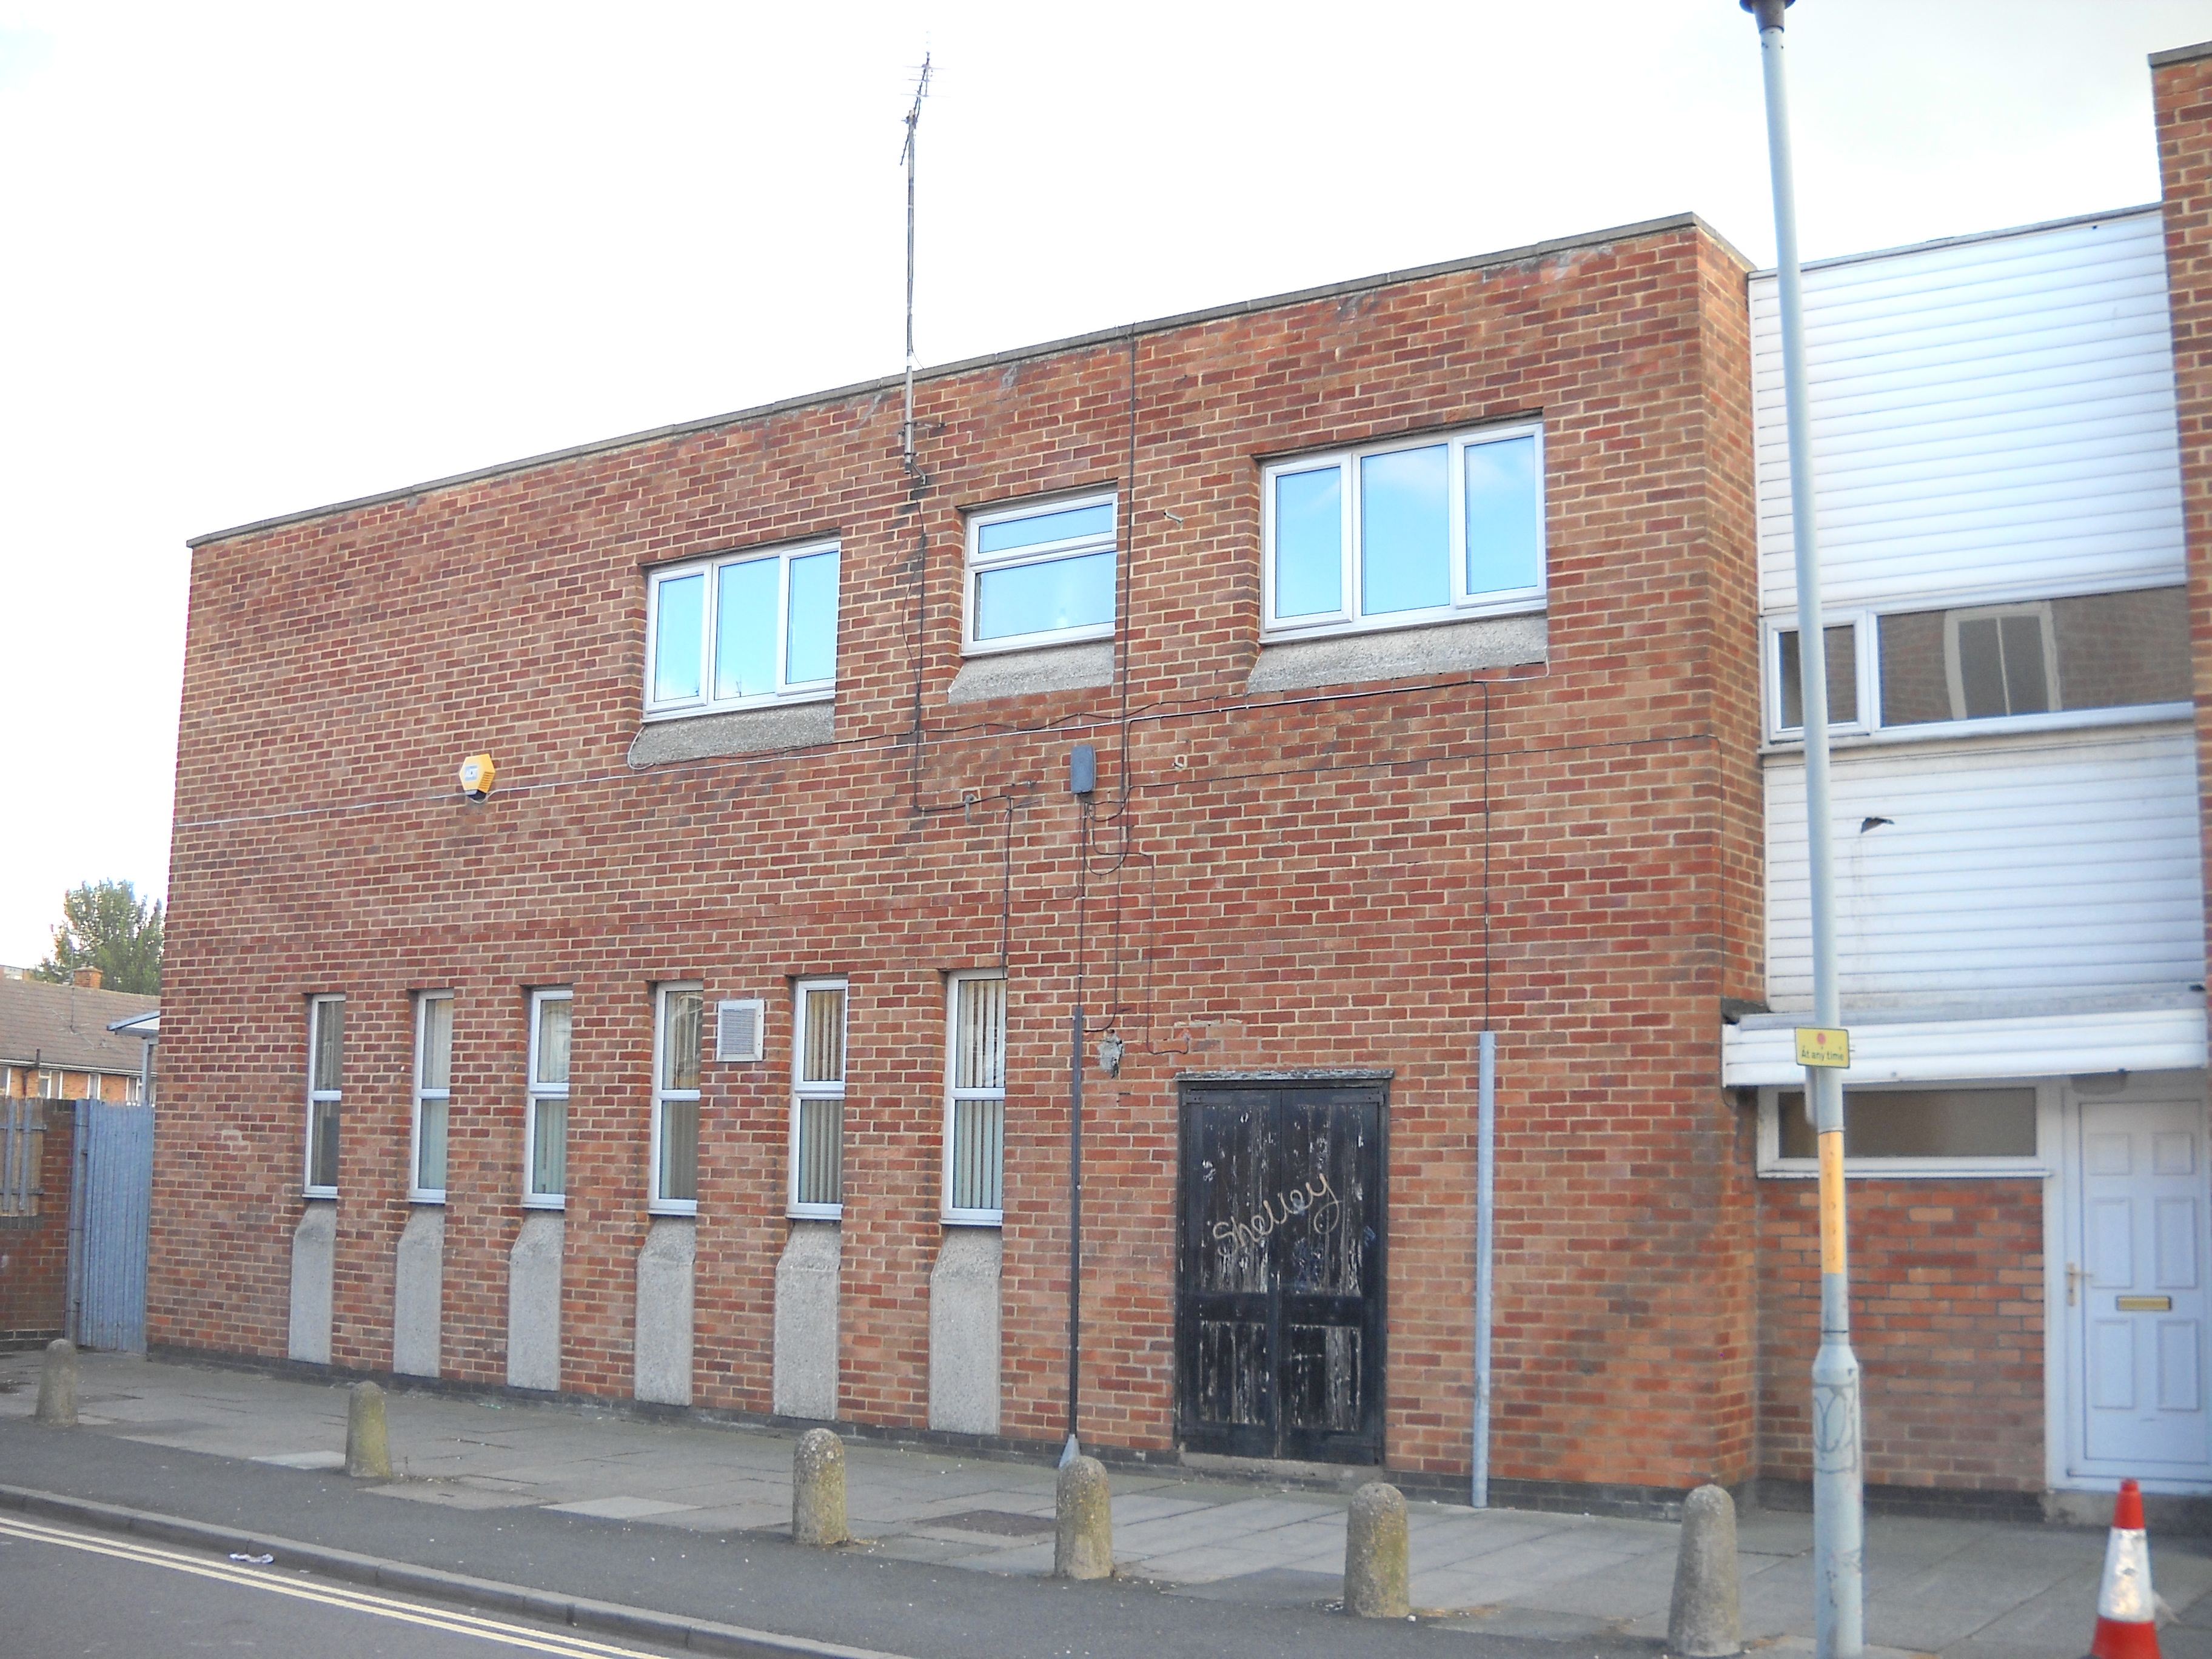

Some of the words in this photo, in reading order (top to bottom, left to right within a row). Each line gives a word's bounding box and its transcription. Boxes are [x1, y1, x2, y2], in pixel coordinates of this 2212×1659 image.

[1801, 1049, 1810, 1059] At
[1811, 1051, 1825, 1061] any
[1826, 1050, 1844, 1061] time
